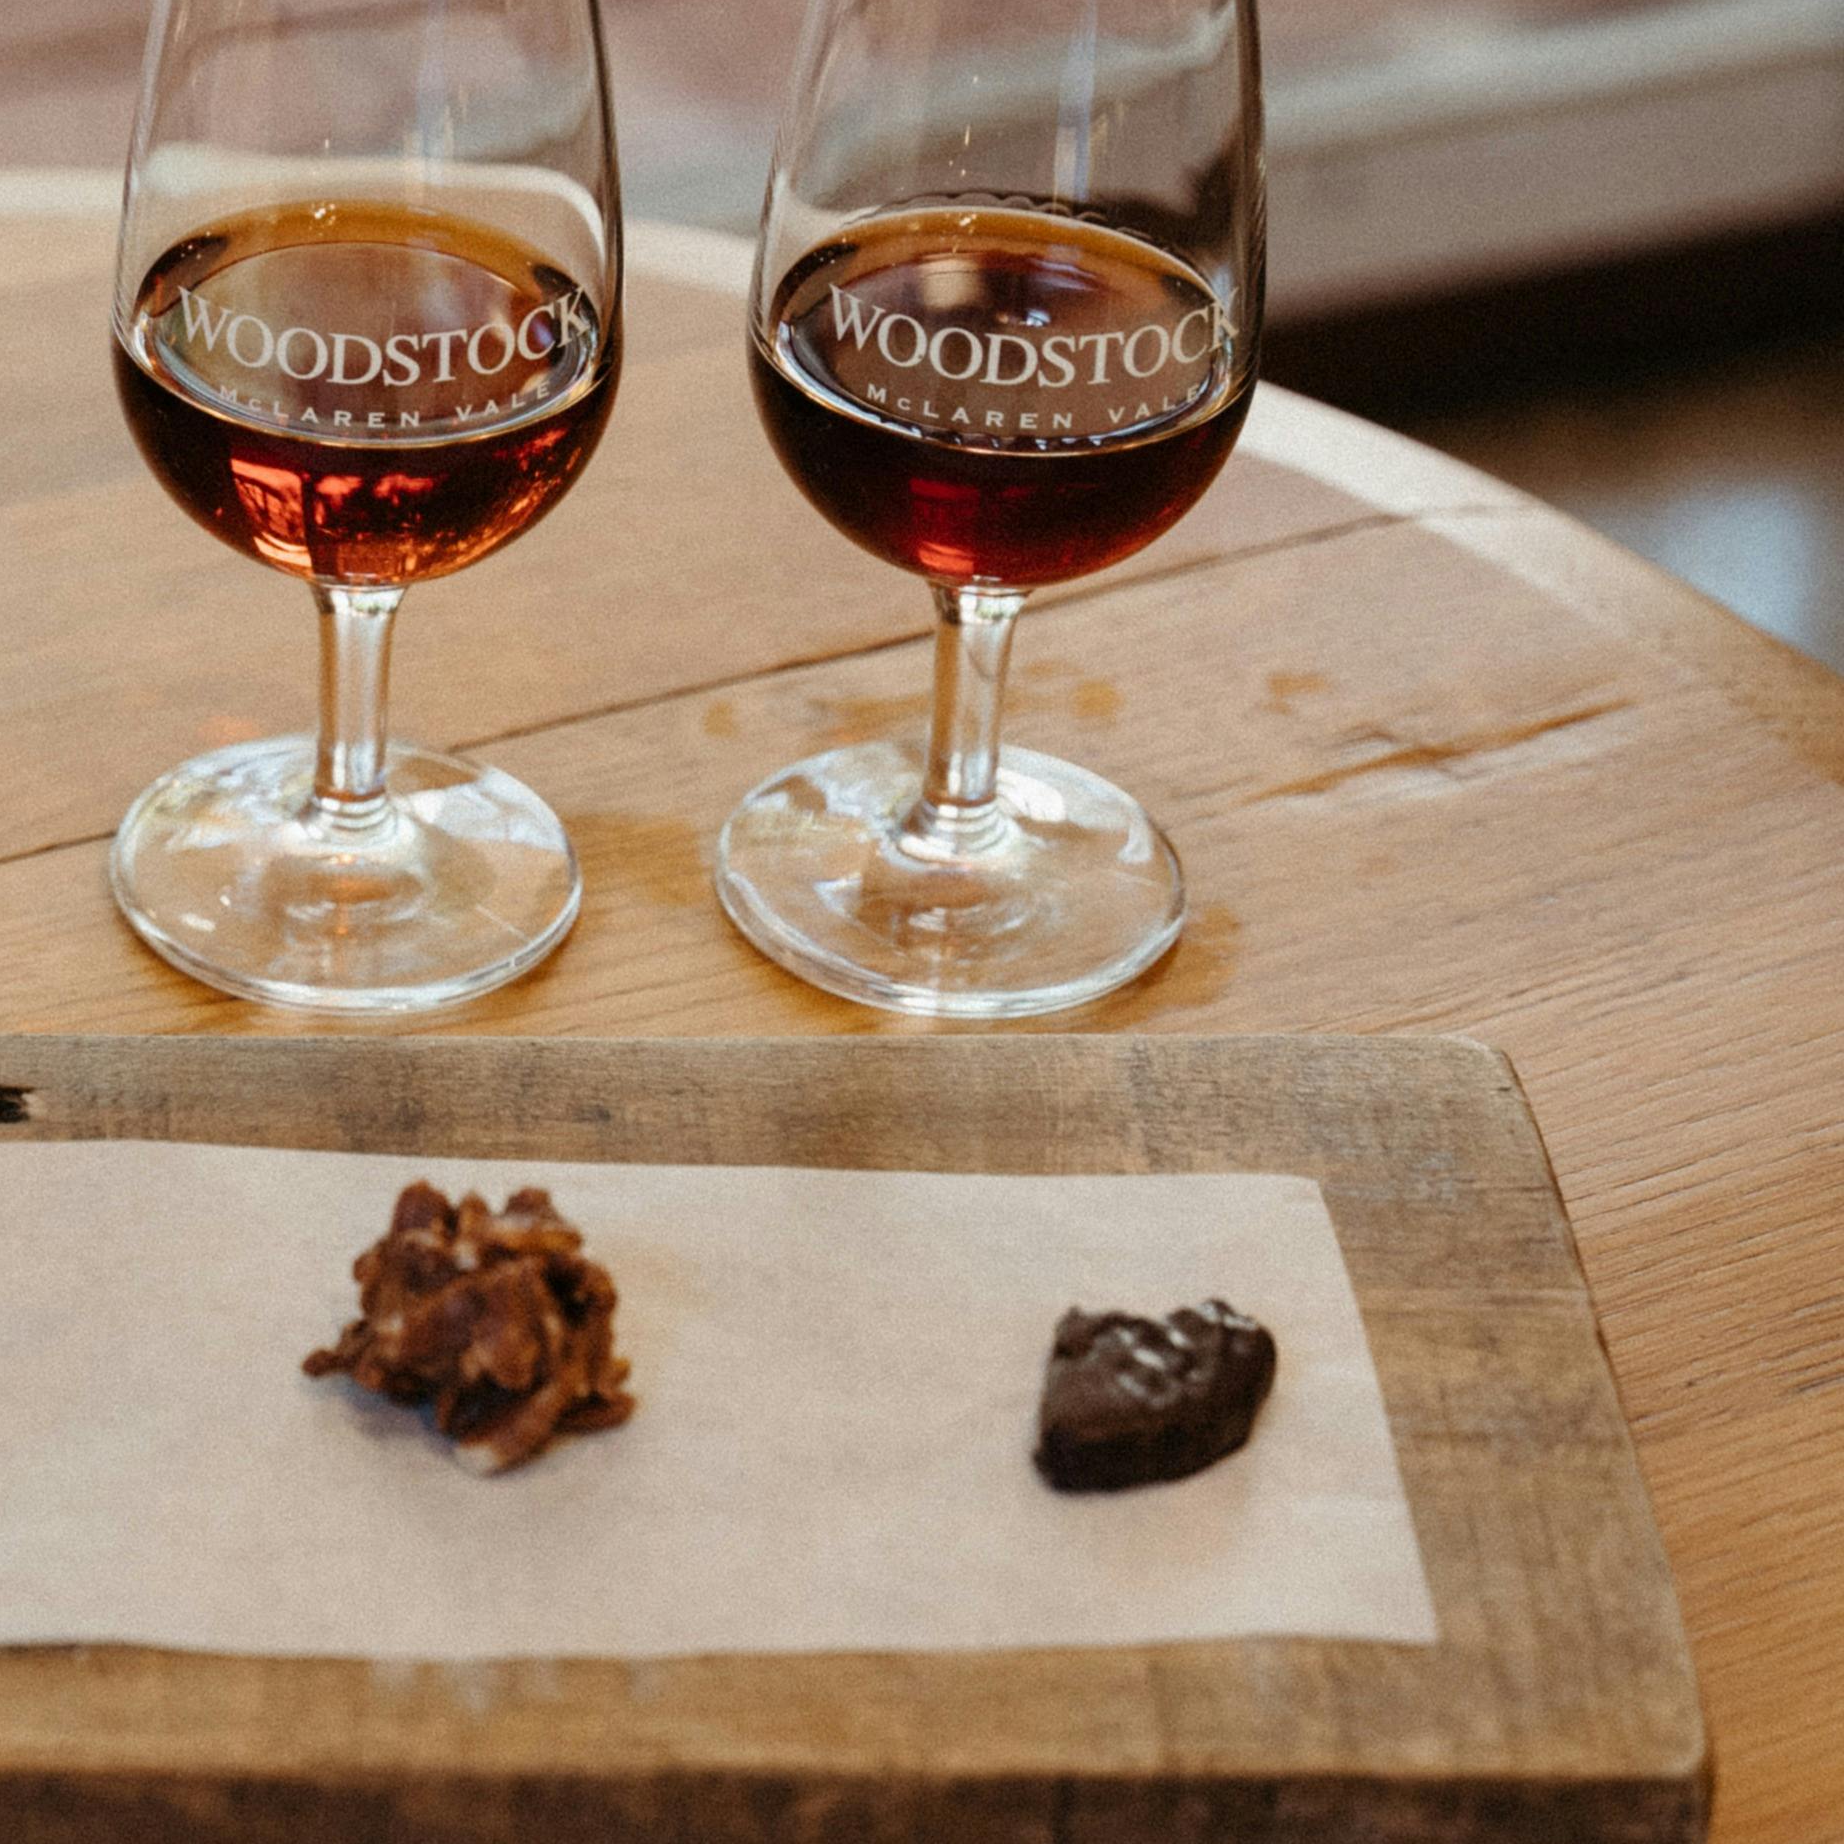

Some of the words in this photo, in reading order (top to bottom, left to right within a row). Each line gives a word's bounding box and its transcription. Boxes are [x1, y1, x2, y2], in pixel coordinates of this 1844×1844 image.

[177, 285, 591, 387] WOODSTOCK
[828, 284, 1240, 388] WOODSTOCK
[219, 385, 420, 429] McLAREN
[455, 381, 551, 422] VALE
[866, 383, 1073, 429] McLAREN
[1107, 385, 1199, 424] VALE
